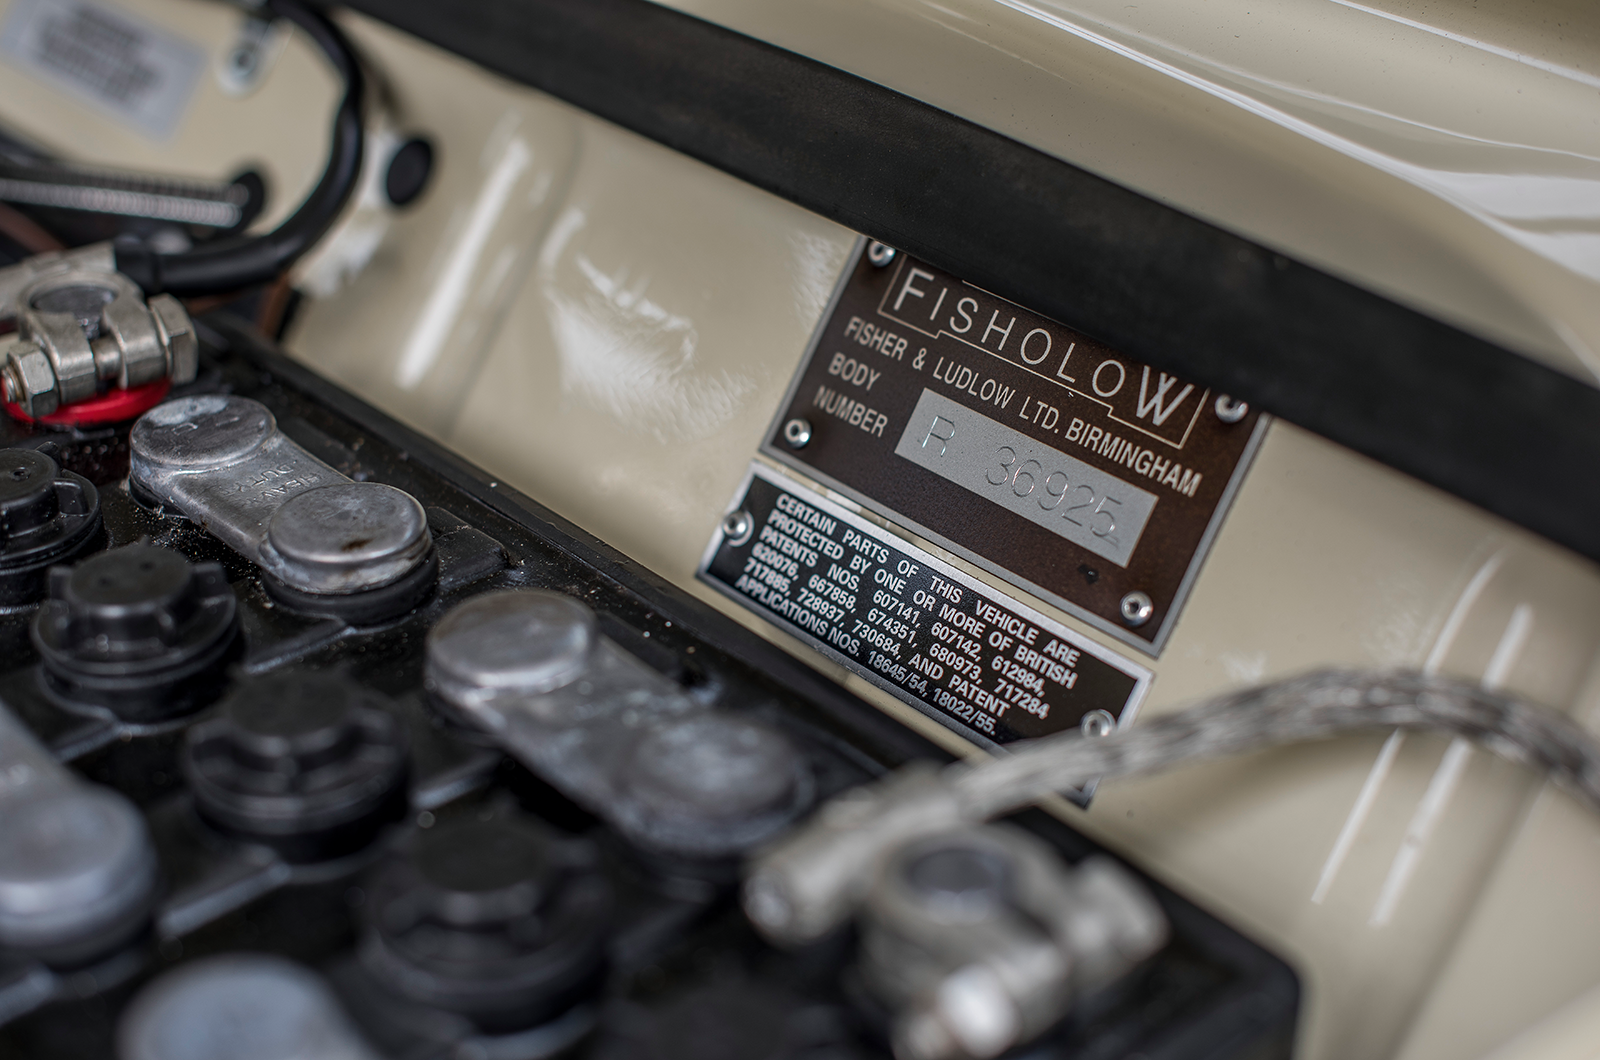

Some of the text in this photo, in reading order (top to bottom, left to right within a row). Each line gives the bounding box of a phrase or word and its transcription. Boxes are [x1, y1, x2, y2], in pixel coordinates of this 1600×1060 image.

[814, 386, 888, 438] NUMBER
[829, 353, 880, 391] BODY
[844, 317, 1202, 497] FISHER & LUDLOW LTD. BIRMINGHAM
[893, 268, 1194, 426] FISHOLOW
[922, 416, 1123, 537] R 36925
[736, 574, 828, 635] APPLICATIONS
[828, 627, 860, 657] NOS.
[751, 542, 1050, 719] 620076, 667858, 674351, 680973, 717284
[759, 526, 1045, 697] PATENTS NOS. 607141, 607142, 612984,
[768, 509, 1077, 689] PROTECTED BY ONE OR MORE OF BRITISH
[776, 493, 1080, 668] CERTAIN PARTS OF THIS VEHICLE ARE
[852, 620, 901, 659] 730684,
[908, 654, 944, 681] AND
[948, 677, 1010, 716] PATENT
